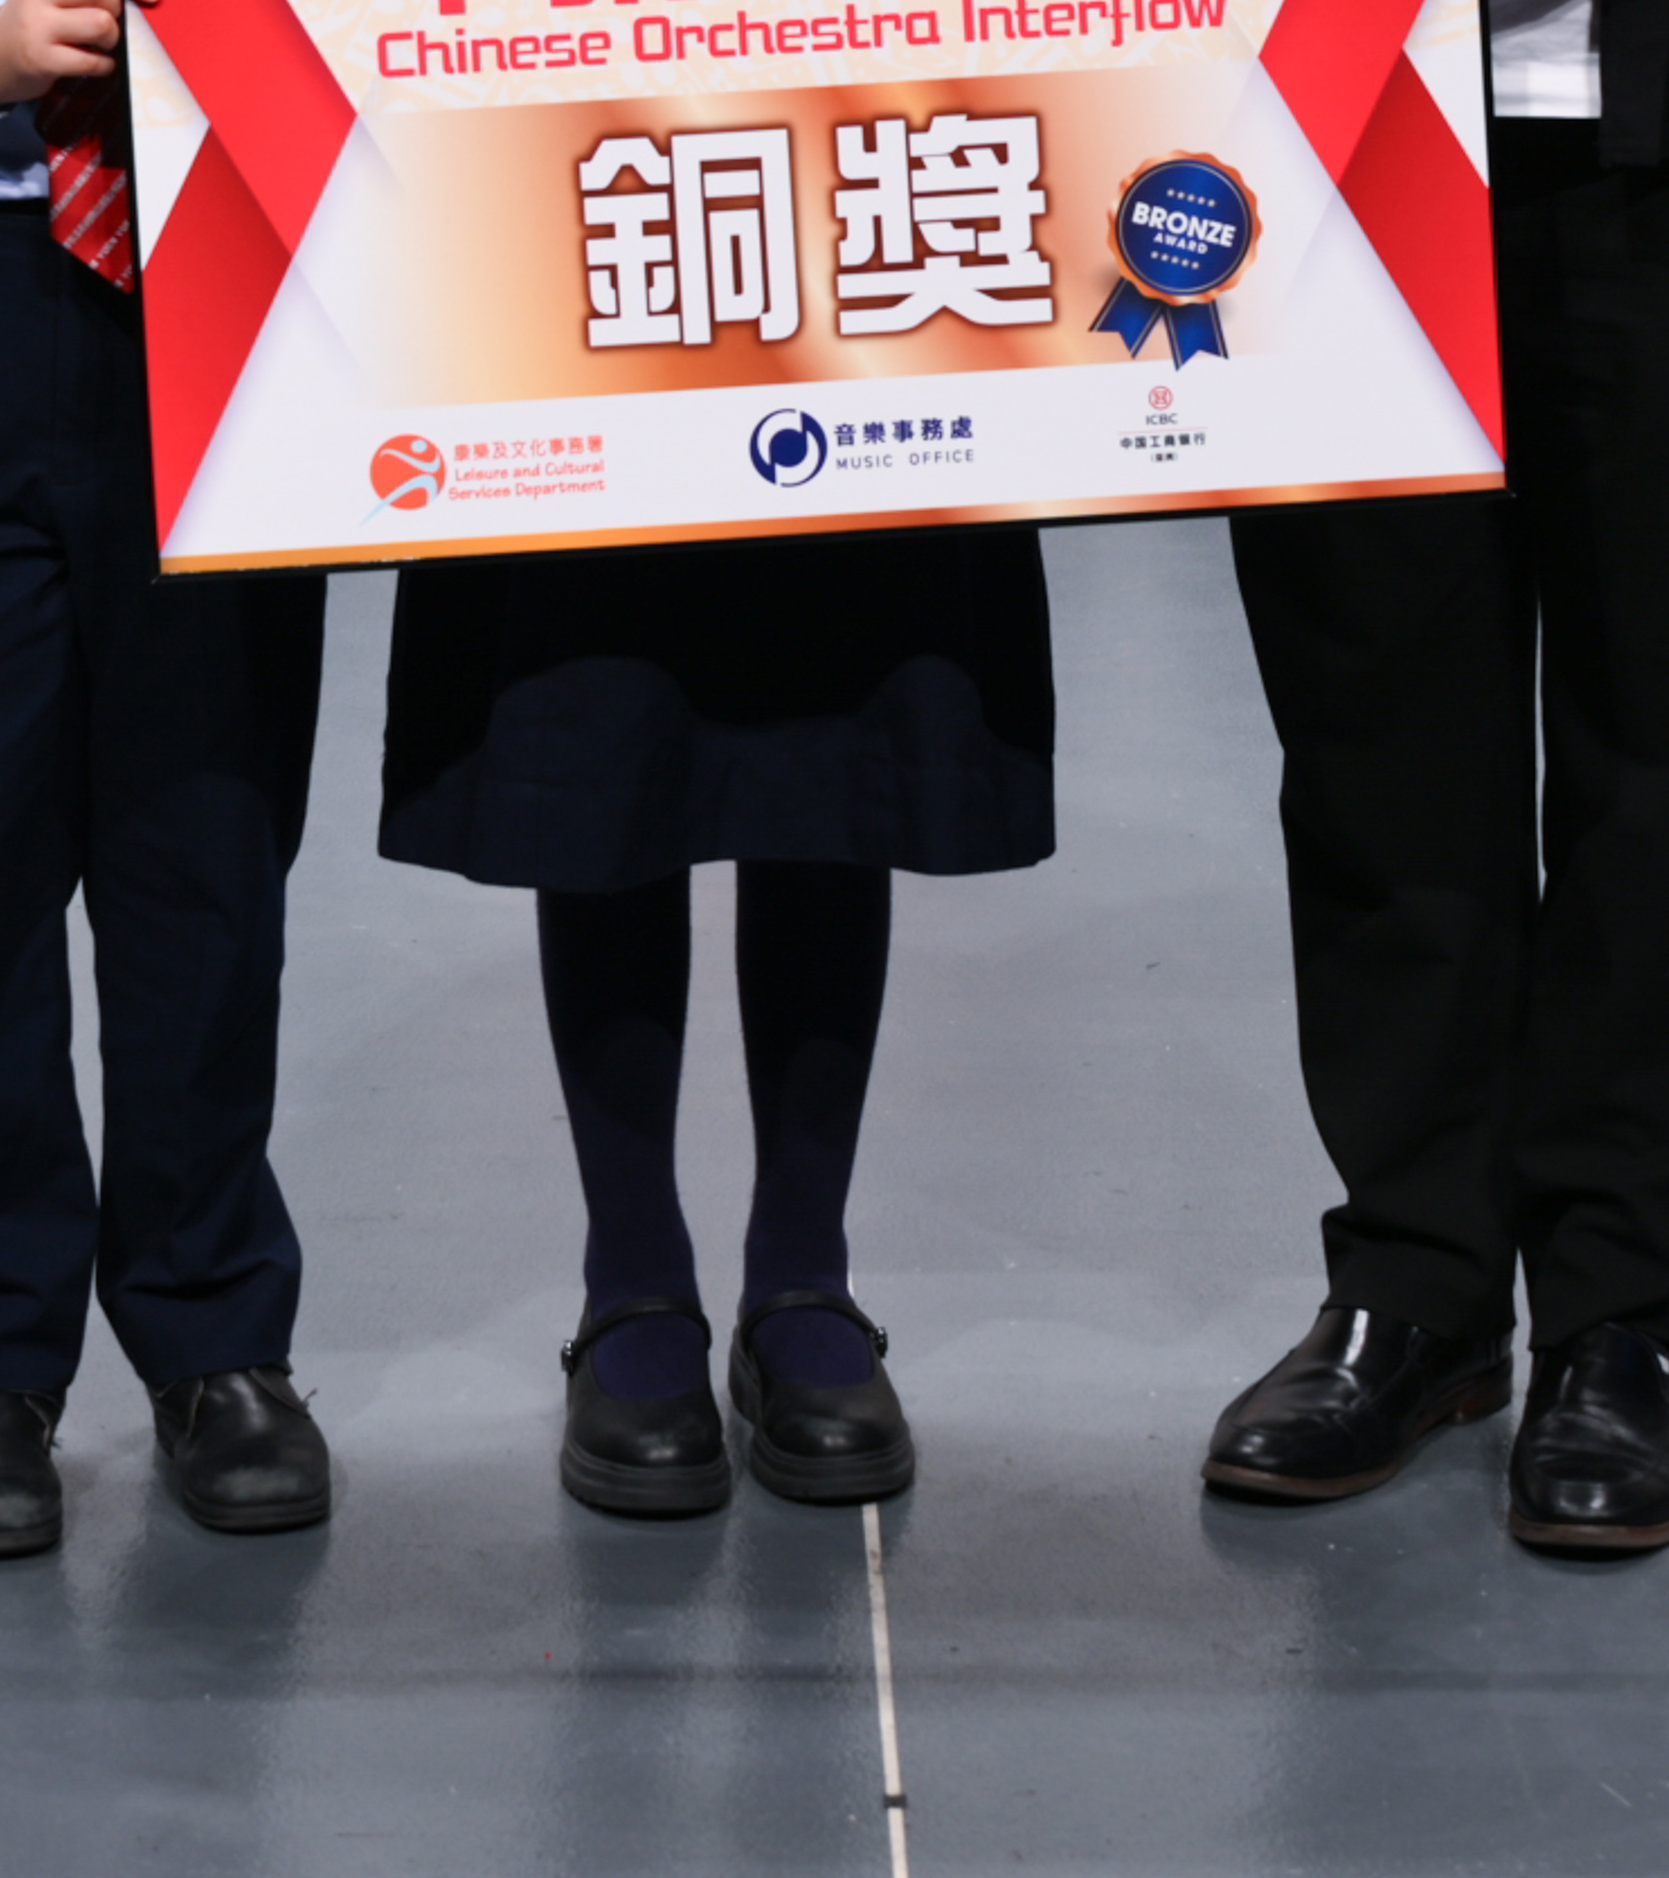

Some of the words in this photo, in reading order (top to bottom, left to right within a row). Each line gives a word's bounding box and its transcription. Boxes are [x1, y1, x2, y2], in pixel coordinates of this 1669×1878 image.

[376, 28, 613, 79] Chinese
[633, 4, 940, 62] Orchestra
[578, 112, 1055, 349] 銅獎
[1132, 201, 1237, 248] BRONZE
[1153, 232, 1209, 255] AWARD
[1145, 413, 1179, 426] ICBC
[834, 416, 974, 447] 音樂事務處
[454, 466, 508, 482] Leisure
[513, 462, 540, 478] and
[545, 459, 605, 477] Cultural
[836, 453, 894, 470] MUSIC
[909, 449, 974, 466] OFFICE
[448, 486, 511, 501] Services
[515, 478, 606, 500] Department
